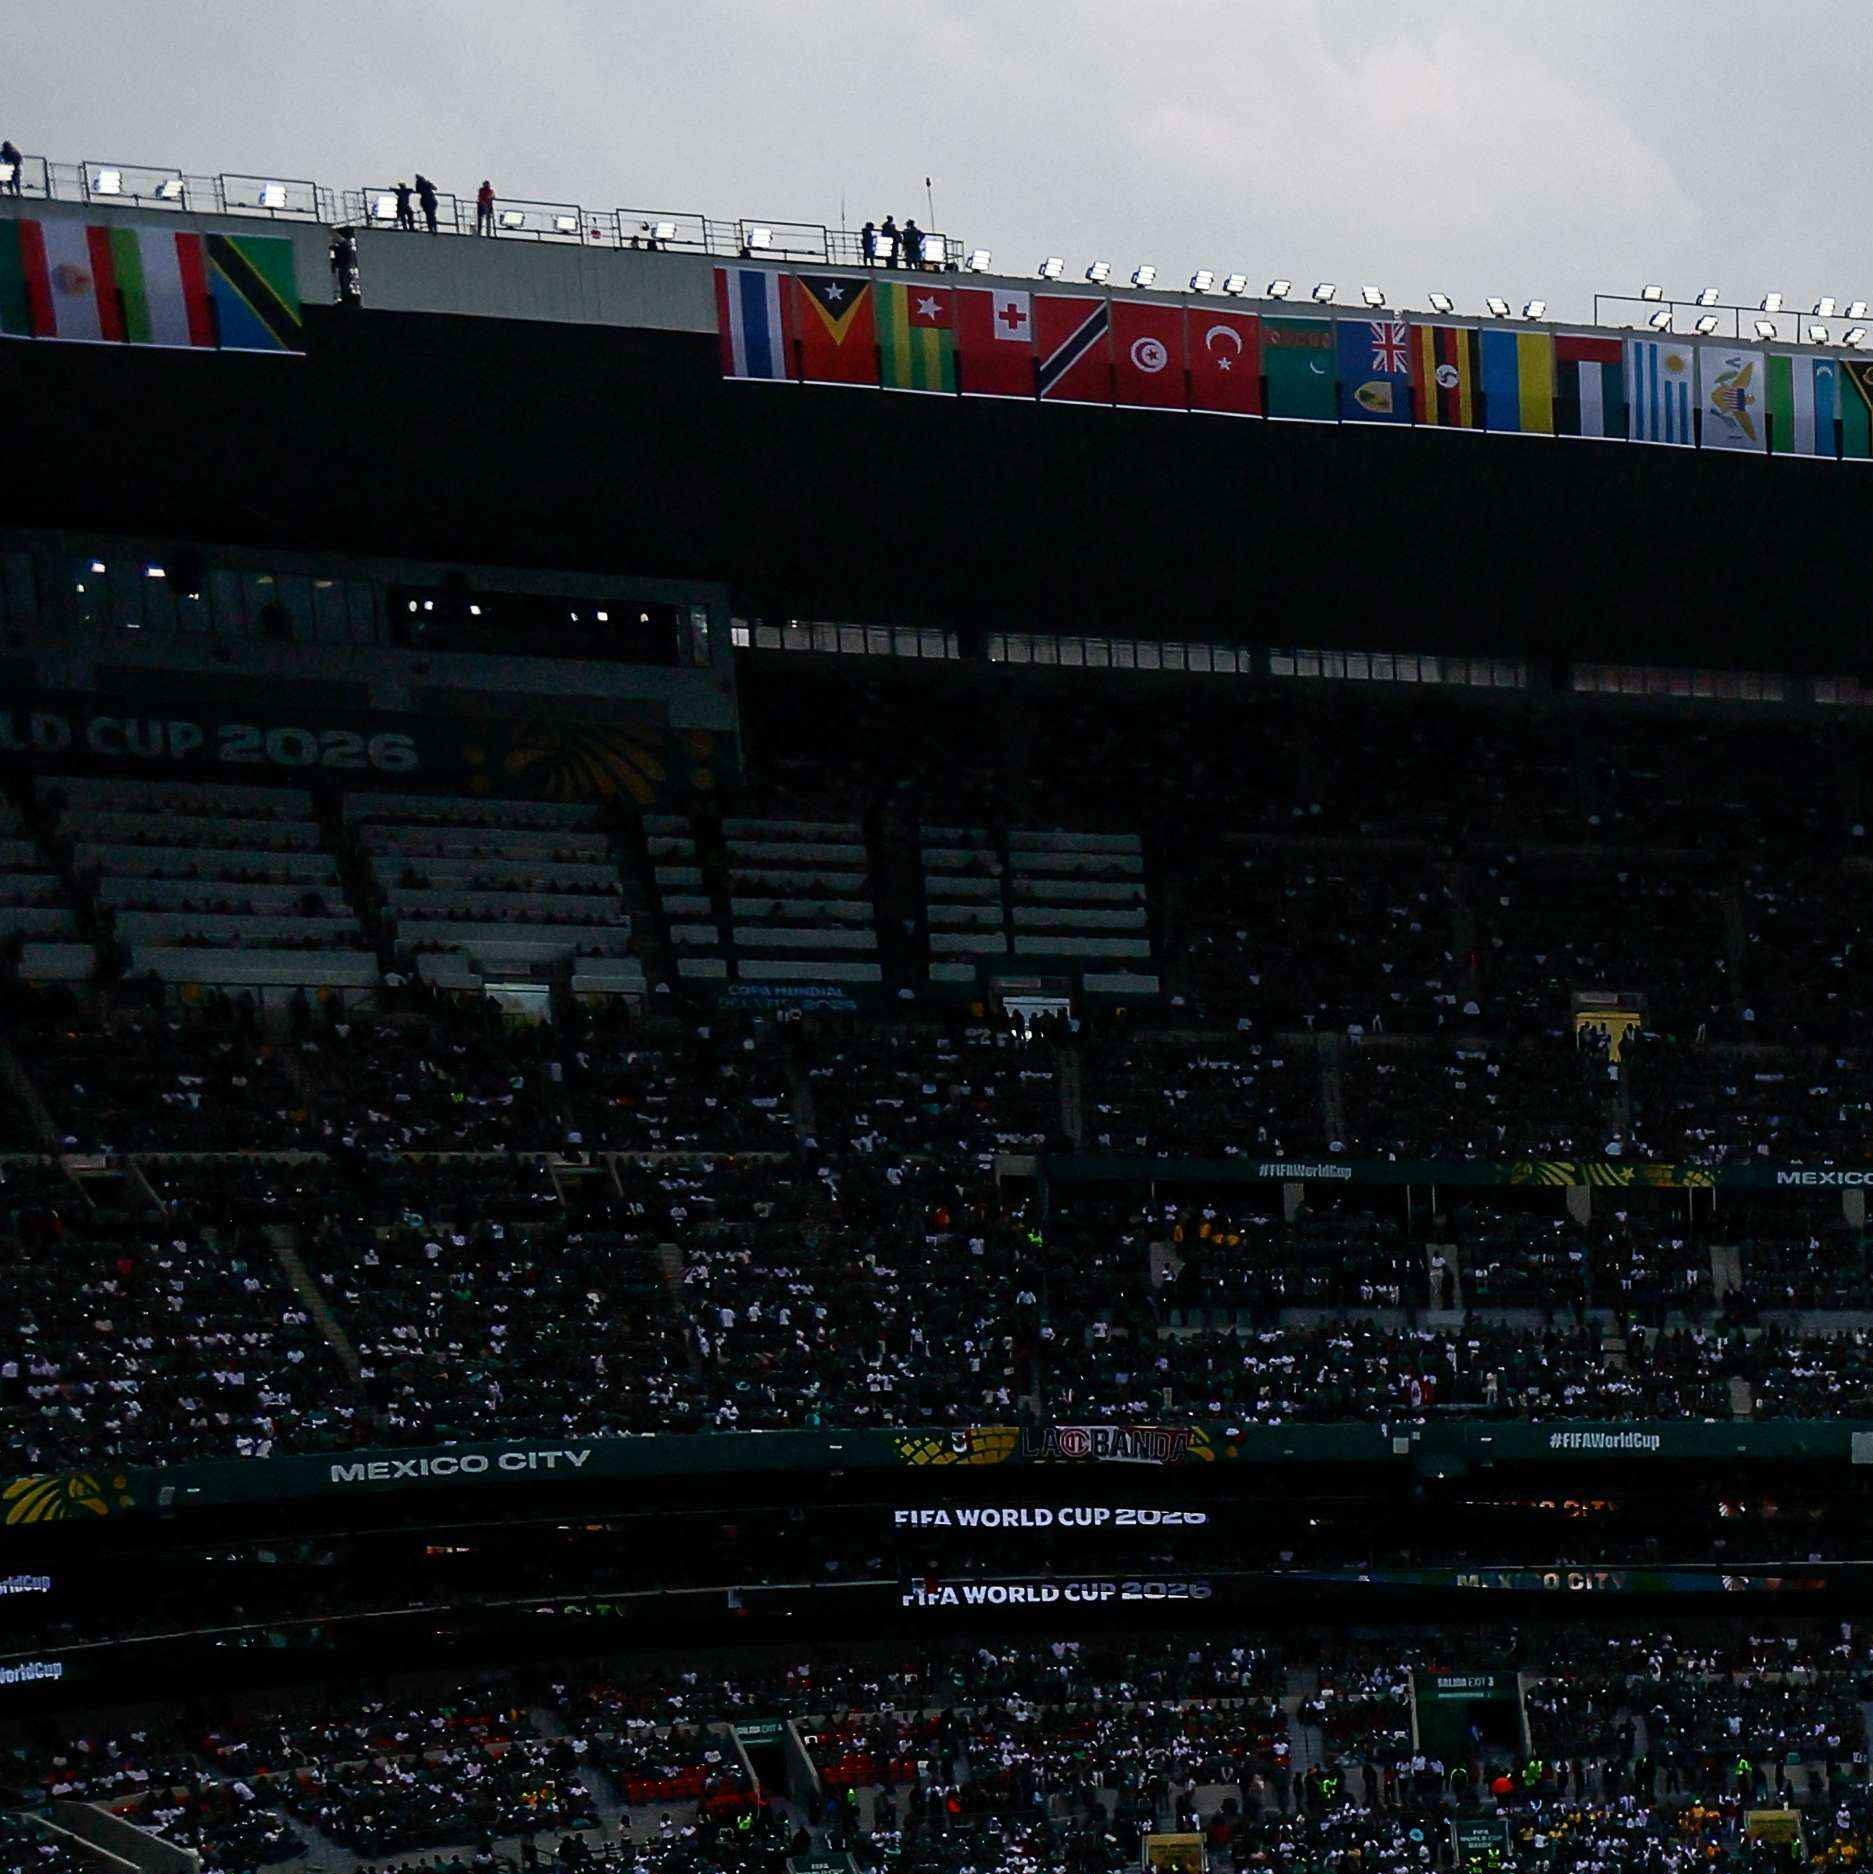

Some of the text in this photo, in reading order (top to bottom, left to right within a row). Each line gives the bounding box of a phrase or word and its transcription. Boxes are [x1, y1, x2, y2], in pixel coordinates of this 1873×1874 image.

[87, 715, 205, 759] CUP
[219, 722, 420, 773] 2026
[1258, 1163, 1353, 1180] #FIFAWorldCup
[1089, 1428, 1188, 1461] BANDA
[1549, 1431, 1661, 1451] #FIFAWorldCup
[329, 1448, 593, 1484] MEXICO CITY
[895, 1508, 1208, 1528] FIFA WORLD CUP 2026
[965, 1585, 1063, 1605] WORLD
[1063, 1583, 1116, 1603] CUP
[1120, 1582, 1213, 1601] 2026
